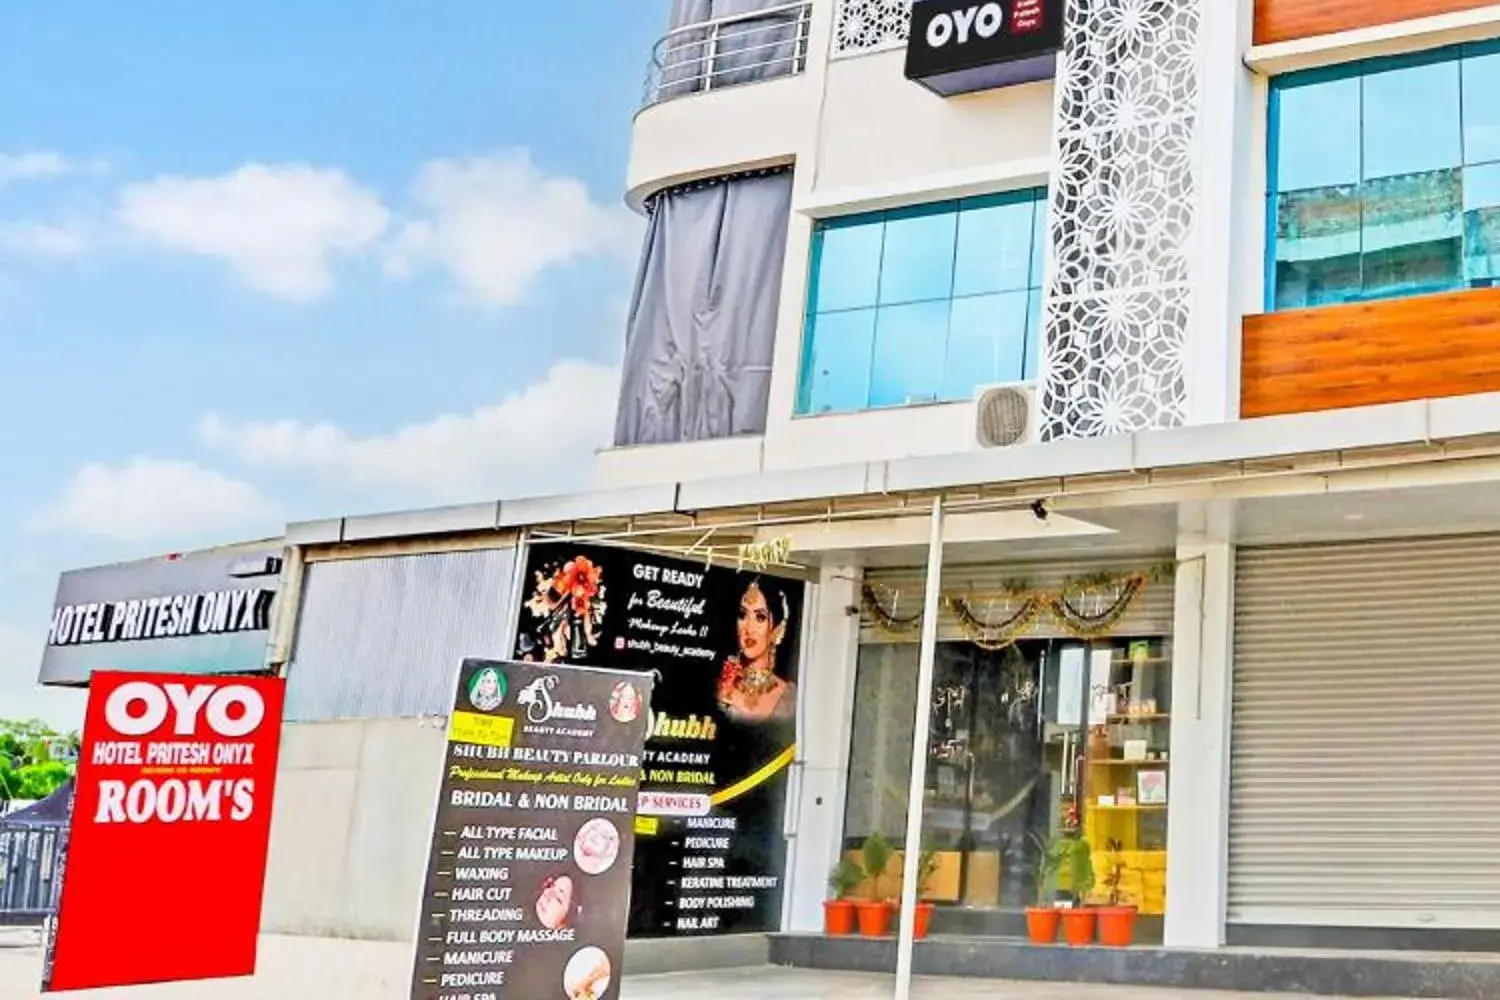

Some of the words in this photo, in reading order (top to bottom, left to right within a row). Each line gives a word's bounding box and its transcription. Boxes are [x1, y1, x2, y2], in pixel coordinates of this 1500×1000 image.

[926, 1, 1003, 47] OYO
[633, 563, 660, 581] GET
[661, 568, 704, 588] READY
[627, 592, 643, 610] for
[646, 589, 706, 619] Beautiful
[108, 593, 200, 640] PRITESH
[200, 588, 261, 633] ONYX
[527, 675, 597, 723] Shubh
[105, 681, 265, 736] OYO
[523, 726, 554, 736] BEAUTY
[92, 741, 143, 765] HOTEL
[145, 742, 210, 765] PRITESH
[212, 743, 255, 765] ONYX
[453, 744, 510, 760] SHUBH
[513, 748, 570, 763] BEAUTY
[573, 751, 639, 767] PARLOUR
[657, 751, 711, 764] ACADEMY
[649, 769, 675, 782] NON
[676, 771, 716, 785] BRIDAL
[94, 778, 255, 823] ROOM'S
[451, 789, 513, 807] BRIDAL
[517, 794, 531, 808] &
[533, 793, 569, 809] NON
[574, 796, 629, 812] BRIDAL
[460, 826, 484, 839] ALL
[486, 826, 516, 840] TYPE
[518, 827, 559, 841] FACIAL
[684, 837, 730, 849] PEDICURE
[457, 846, 481, 860] ALL
[483, 847, 513, 860] TYPE
[516, 848, 568, 861] MAKEUP
[682, 856, 706, 869] HAIR
[707, 857, 725, 868] SPA
[455, 867, 509, 880] WAXING
[451, 888, 483, 900] HAIR
[486, 887, 512, 900] CUT
[449, 908, 523, 921] THREADING
[699, 916, 720, 929] ART
[446, 931, 477, 944] FULL
[479, 930, 515, 943] BODY
[517, 928, 575, 942] MASSAGE
[443, 950, 514, 965] MANICURE
[440, 971, 504, 987] PEDICURE
